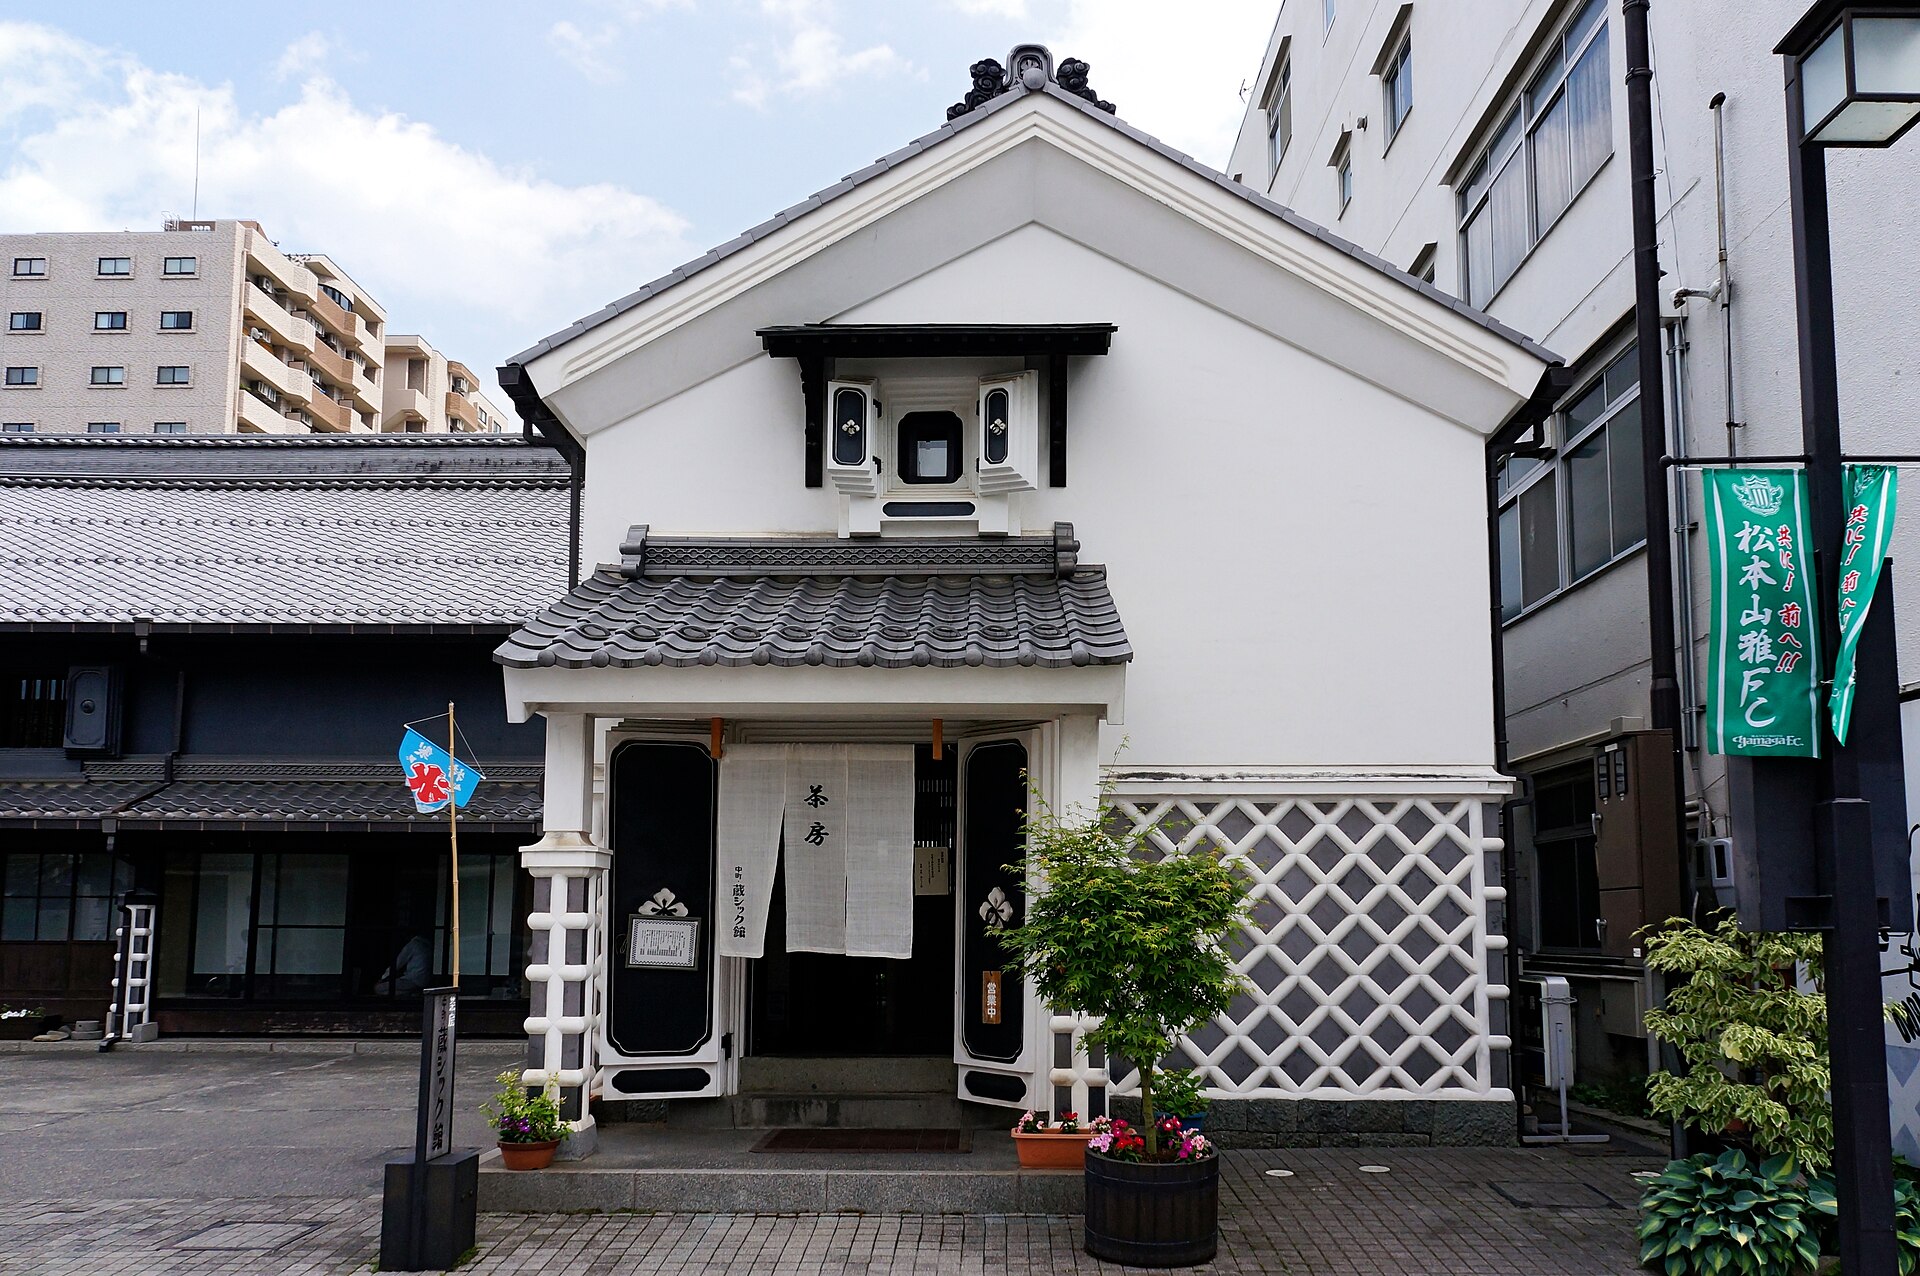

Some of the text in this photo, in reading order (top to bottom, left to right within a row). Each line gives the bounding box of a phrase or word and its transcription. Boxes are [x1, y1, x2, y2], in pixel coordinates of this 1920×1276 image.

[1734, 520, 1778, 728] 松本山雅FC
[804, 784, 829, 846] 茶房
[987, 982, 997, 1018] 営業中
